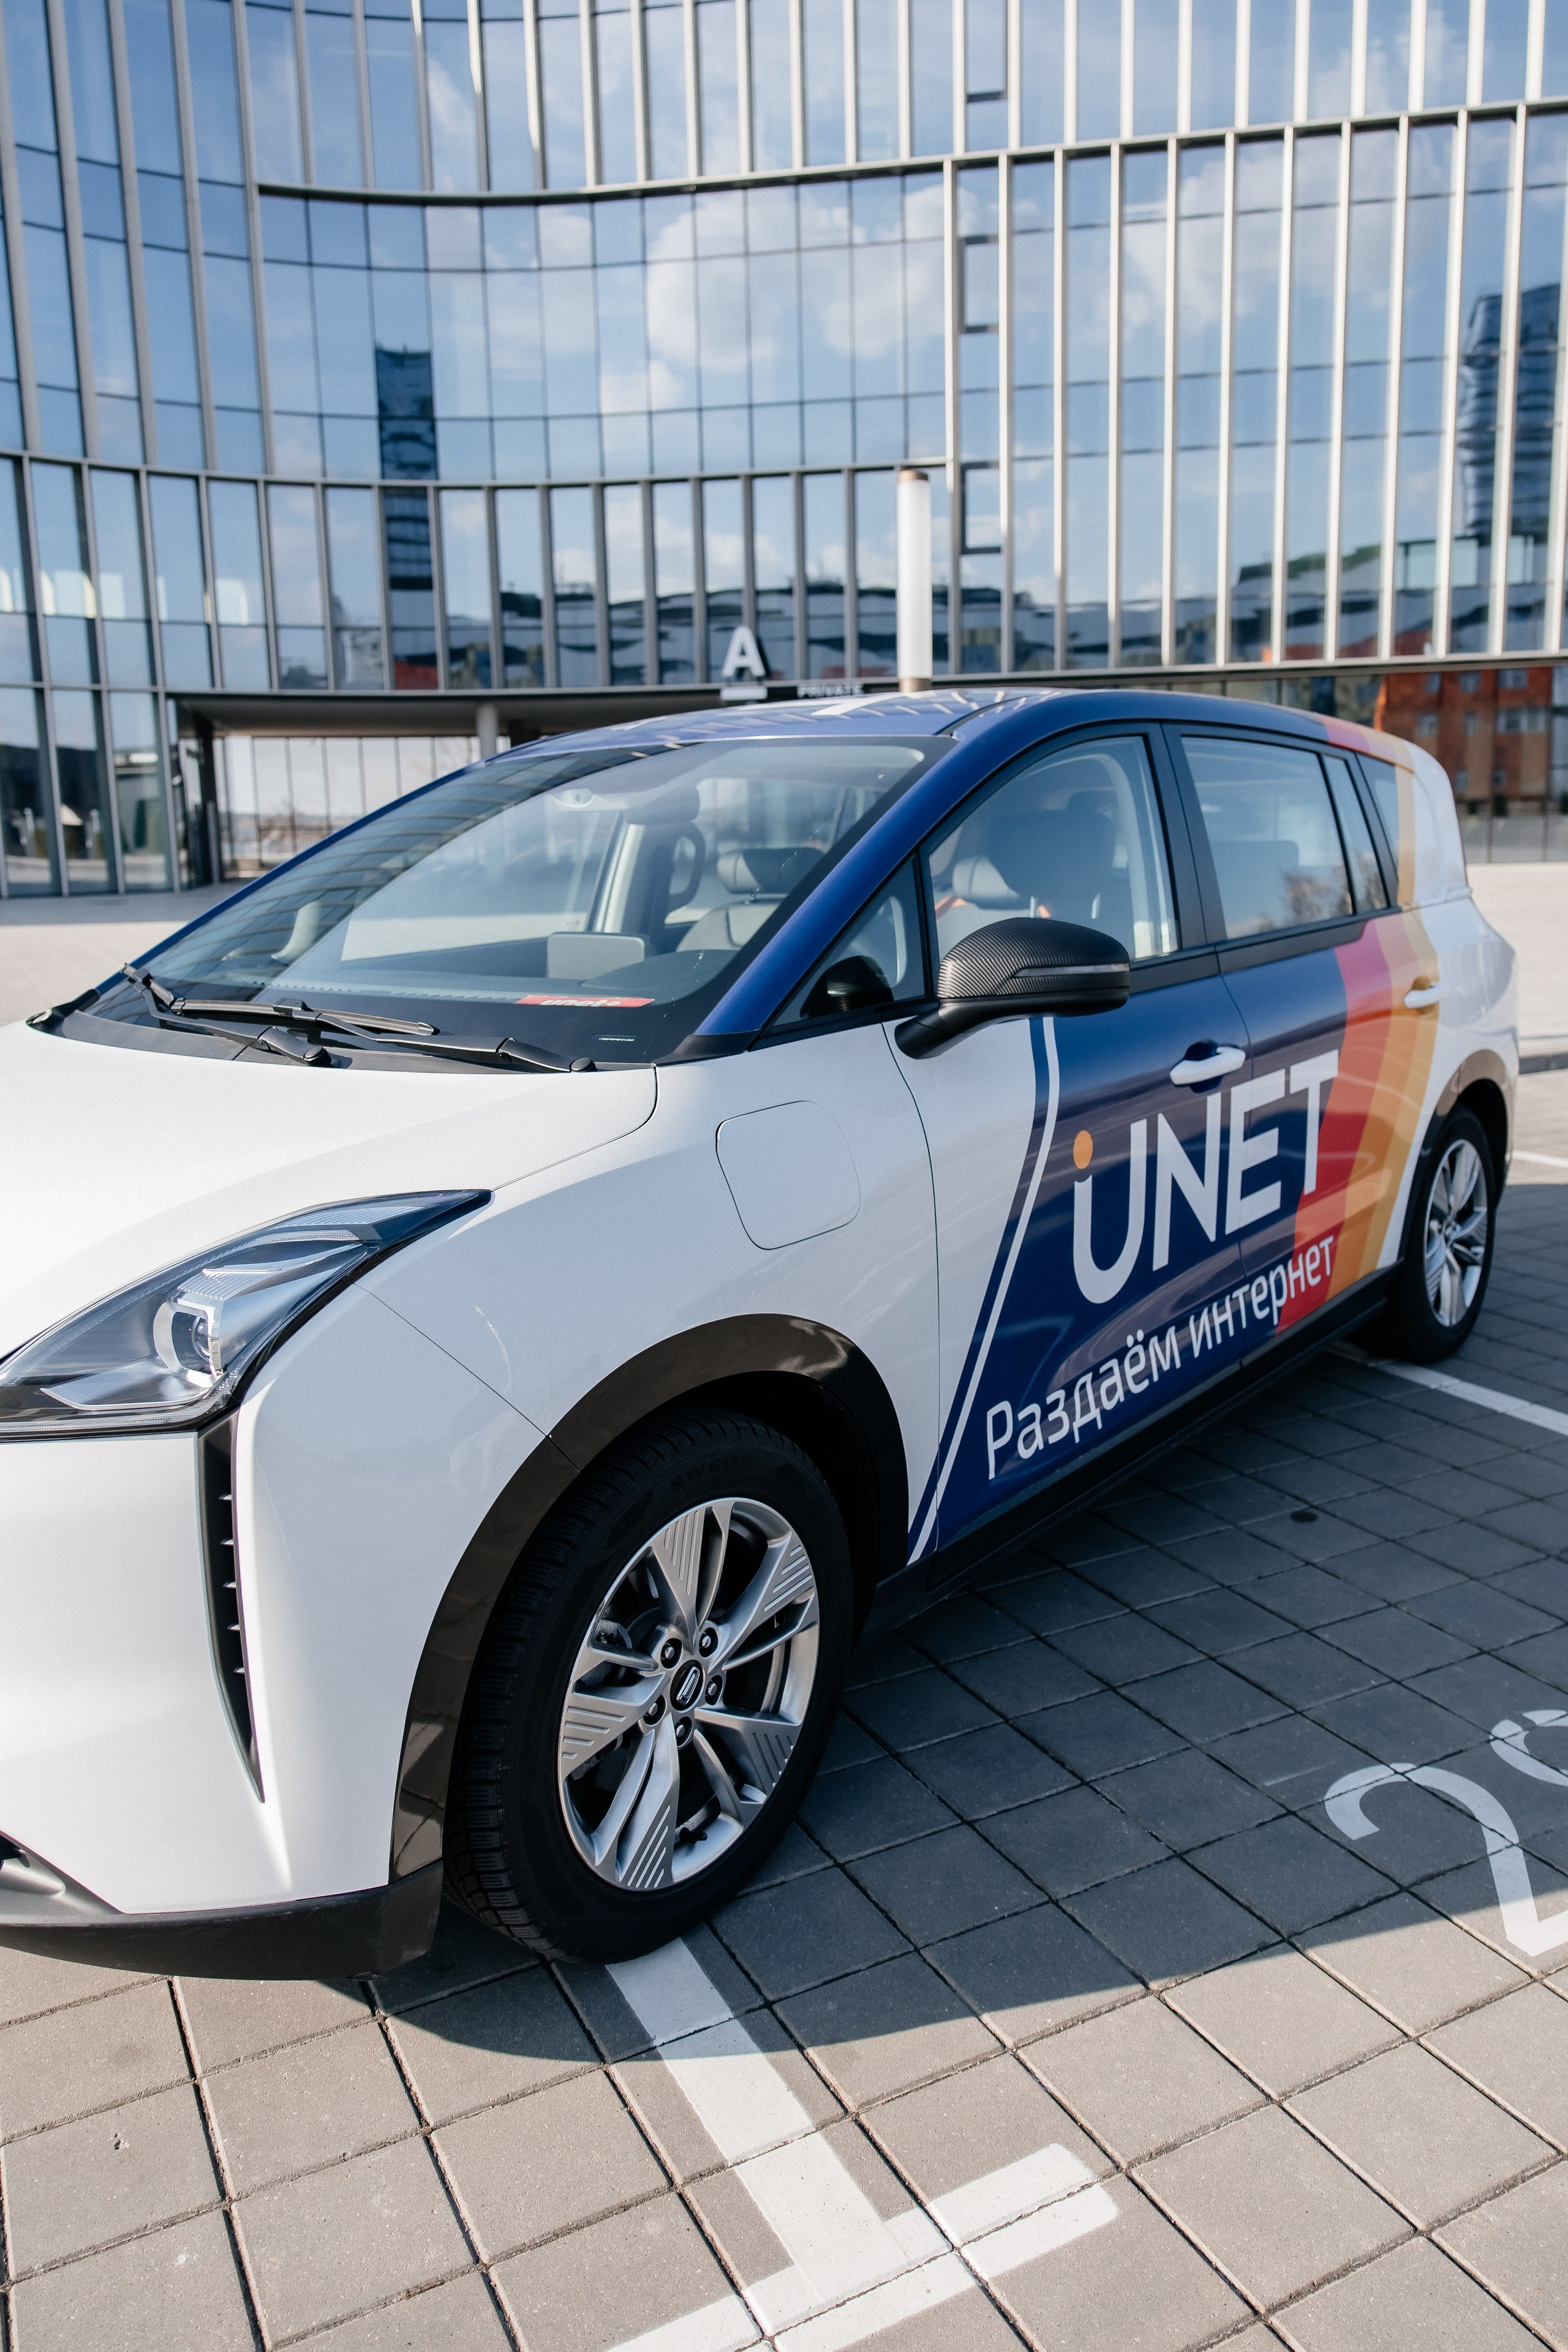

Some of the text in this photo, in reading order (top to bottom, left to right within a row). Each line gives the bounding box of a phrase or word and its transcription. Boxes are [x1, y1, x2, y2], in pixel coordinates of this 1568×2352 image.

[722, 626, 766, 677] A
[987, 1236, 1334, 1479] Раздаём интернет
